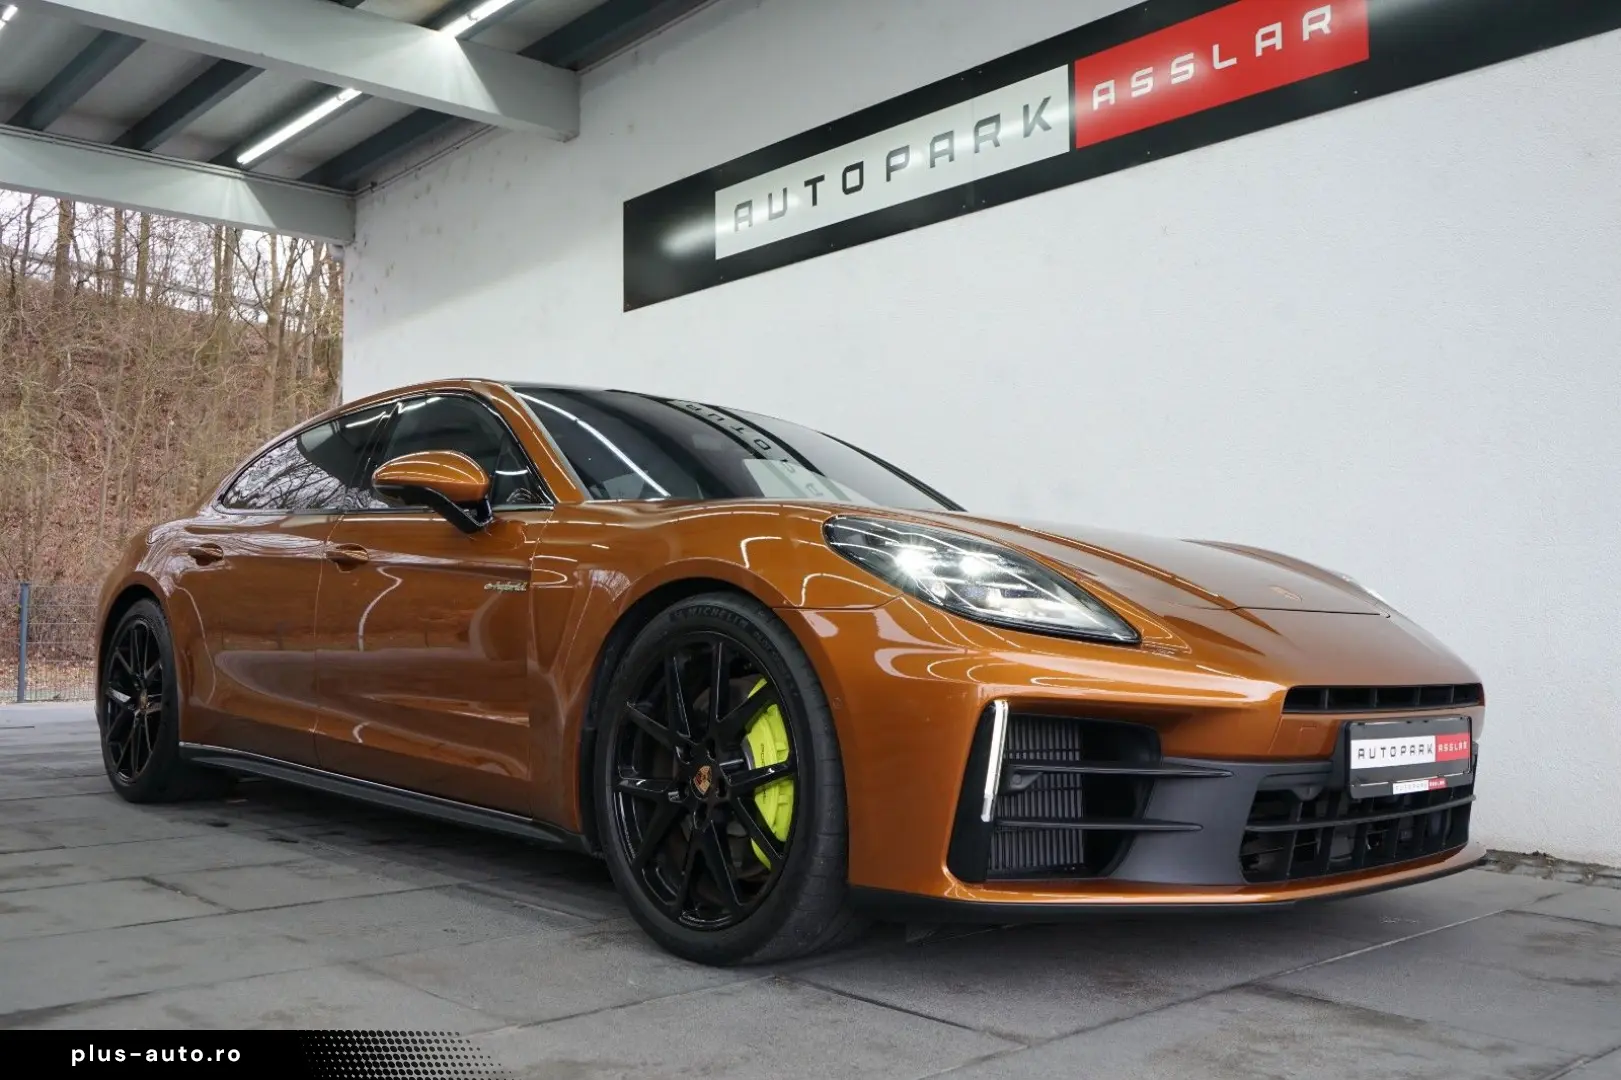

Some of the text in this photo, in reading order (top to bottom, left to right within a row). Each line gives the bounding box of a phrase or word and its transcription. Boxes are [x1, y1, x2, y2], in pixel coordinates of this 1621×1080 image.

[734, 5, 1331, 232] AUTOPARK ASSLAR
[688, 605, 748, 629] MICHELIN
[1358, 740, 1468, 759] AUTOPARK ASSLAR
